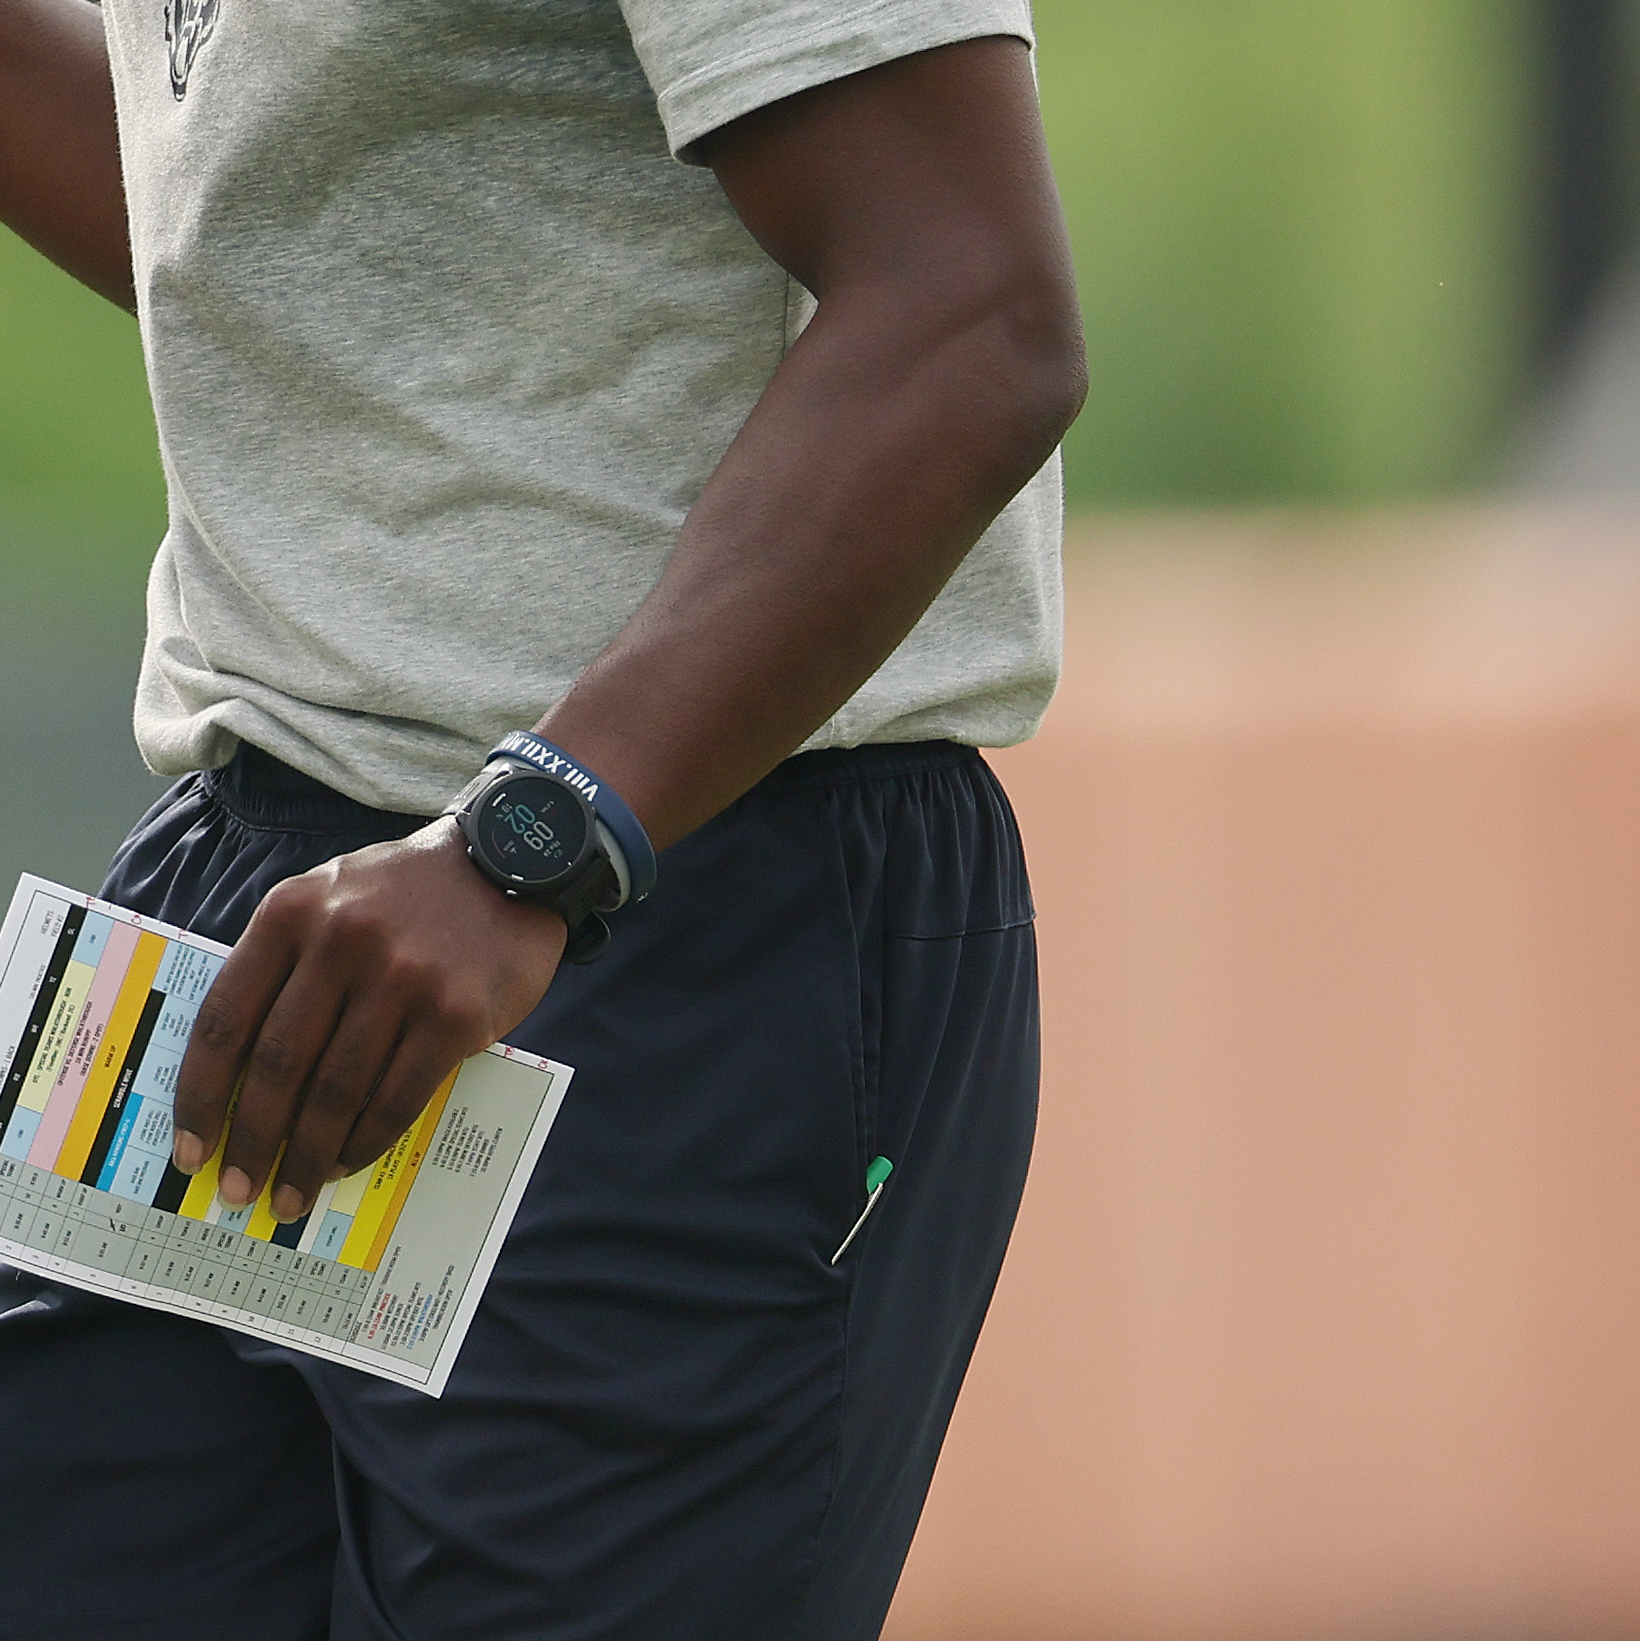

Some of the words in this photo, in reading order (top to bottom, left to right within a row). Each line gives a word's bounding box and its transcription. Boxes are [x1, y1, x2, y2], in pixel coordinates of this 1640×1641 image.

[39, 909, 55, 935] HELMETS
[49, 921, 62, 938] FIELD
[4, 1043, 16, 1060] BACK
[56, 1064, 70, 1086] OFFENSE
[67, 1035, 80, 1057] DEFENSE
[74, 999, 93, 1037] WALKTHROUGH
[103, 1051, 114, 1069] WARM
[112, 1081, 129, 1109] SCRAMBLE
